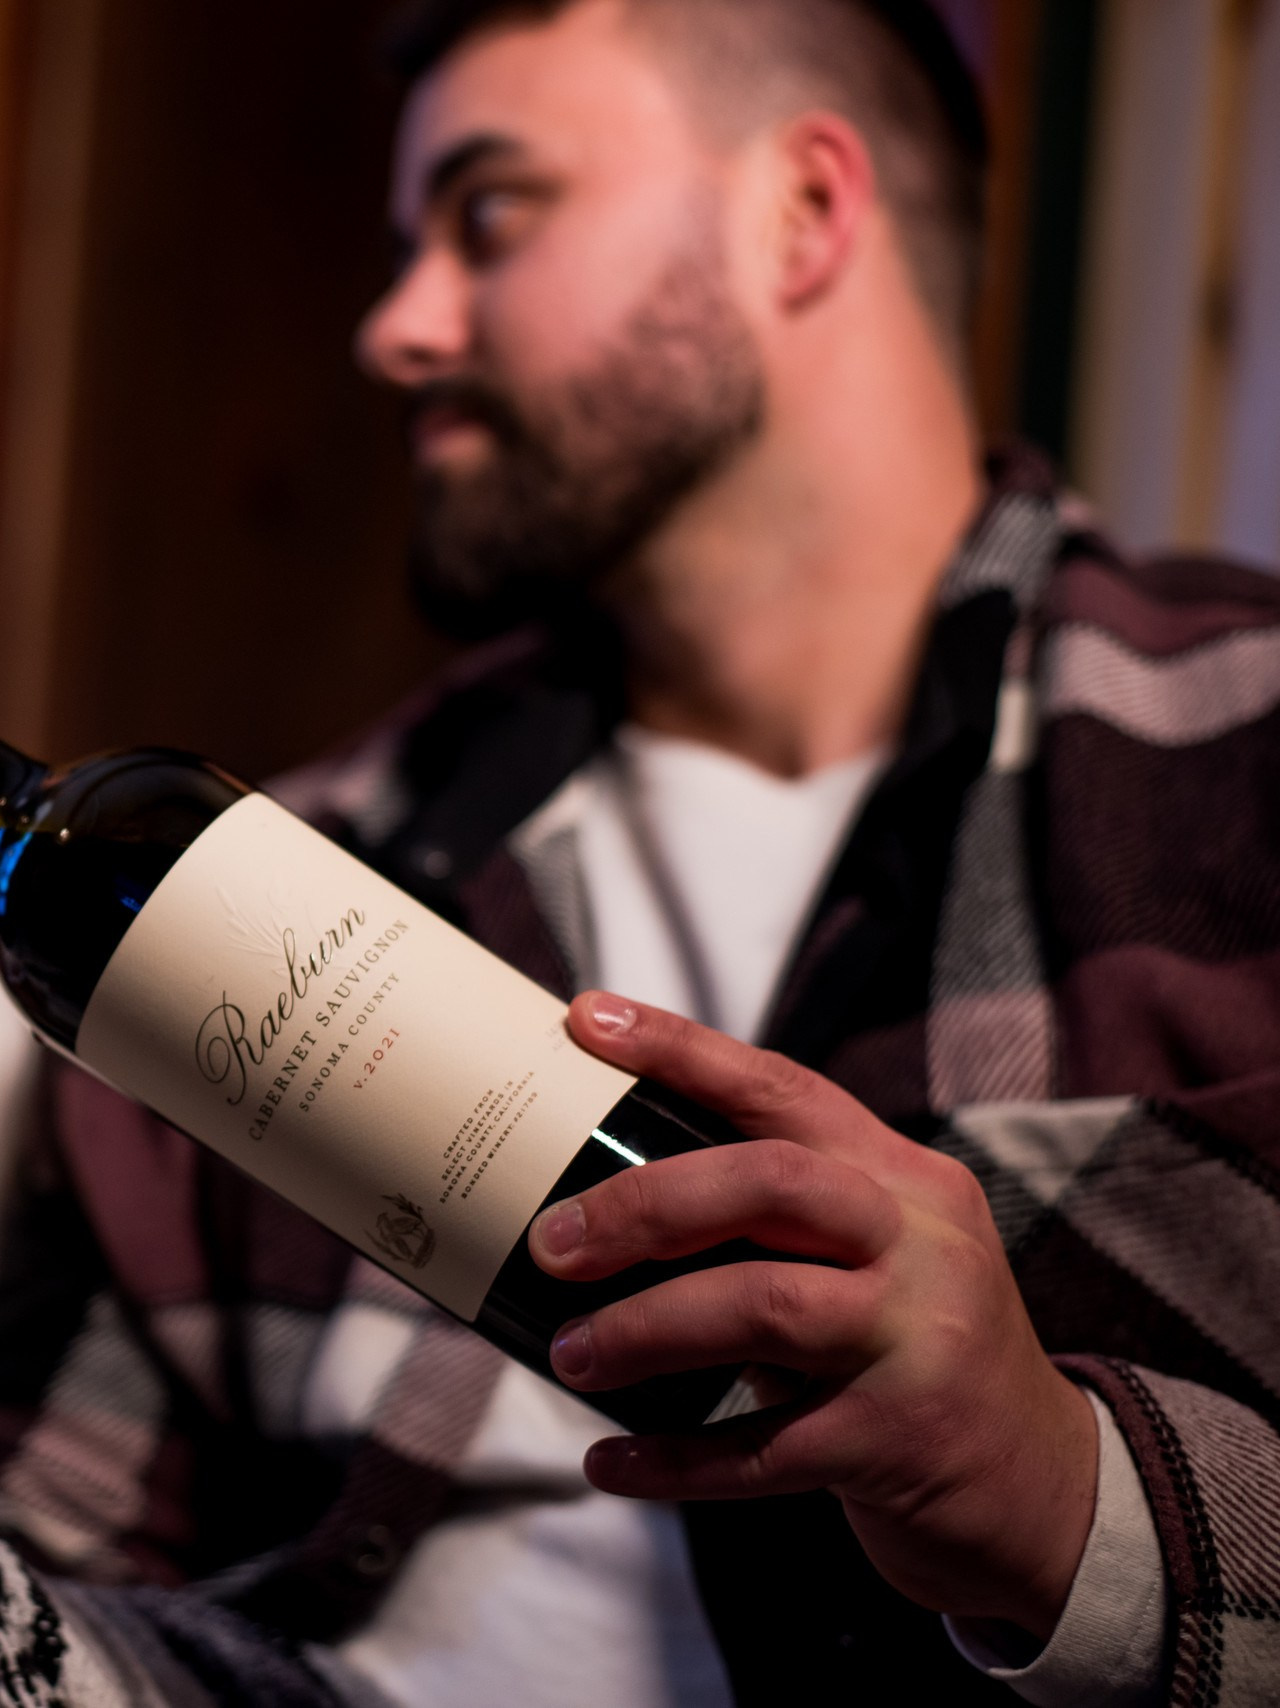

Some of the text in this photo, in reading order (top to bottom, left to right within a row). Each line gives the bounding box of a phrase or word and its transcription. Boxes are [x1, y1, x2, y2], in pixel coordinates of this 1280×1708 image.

[195, 908, 365, 1105] Raeburn
[248, 918, 410, 1141] CABERNET SAUVIGNON
[299, 972, 400, 1112] SONOMA COUNTY
[353, 1028, 400, 1090] v.2021
[440, 1071, 535, 1203] SONOMA COUNTY, CALIFORNIA
[442, 1080, 513, 1180] SELECT VINEYARDS IN
[443, 1089, 493, 1159] CRAFTED FROM
[461, 1161, 488, 1199] BONDED
